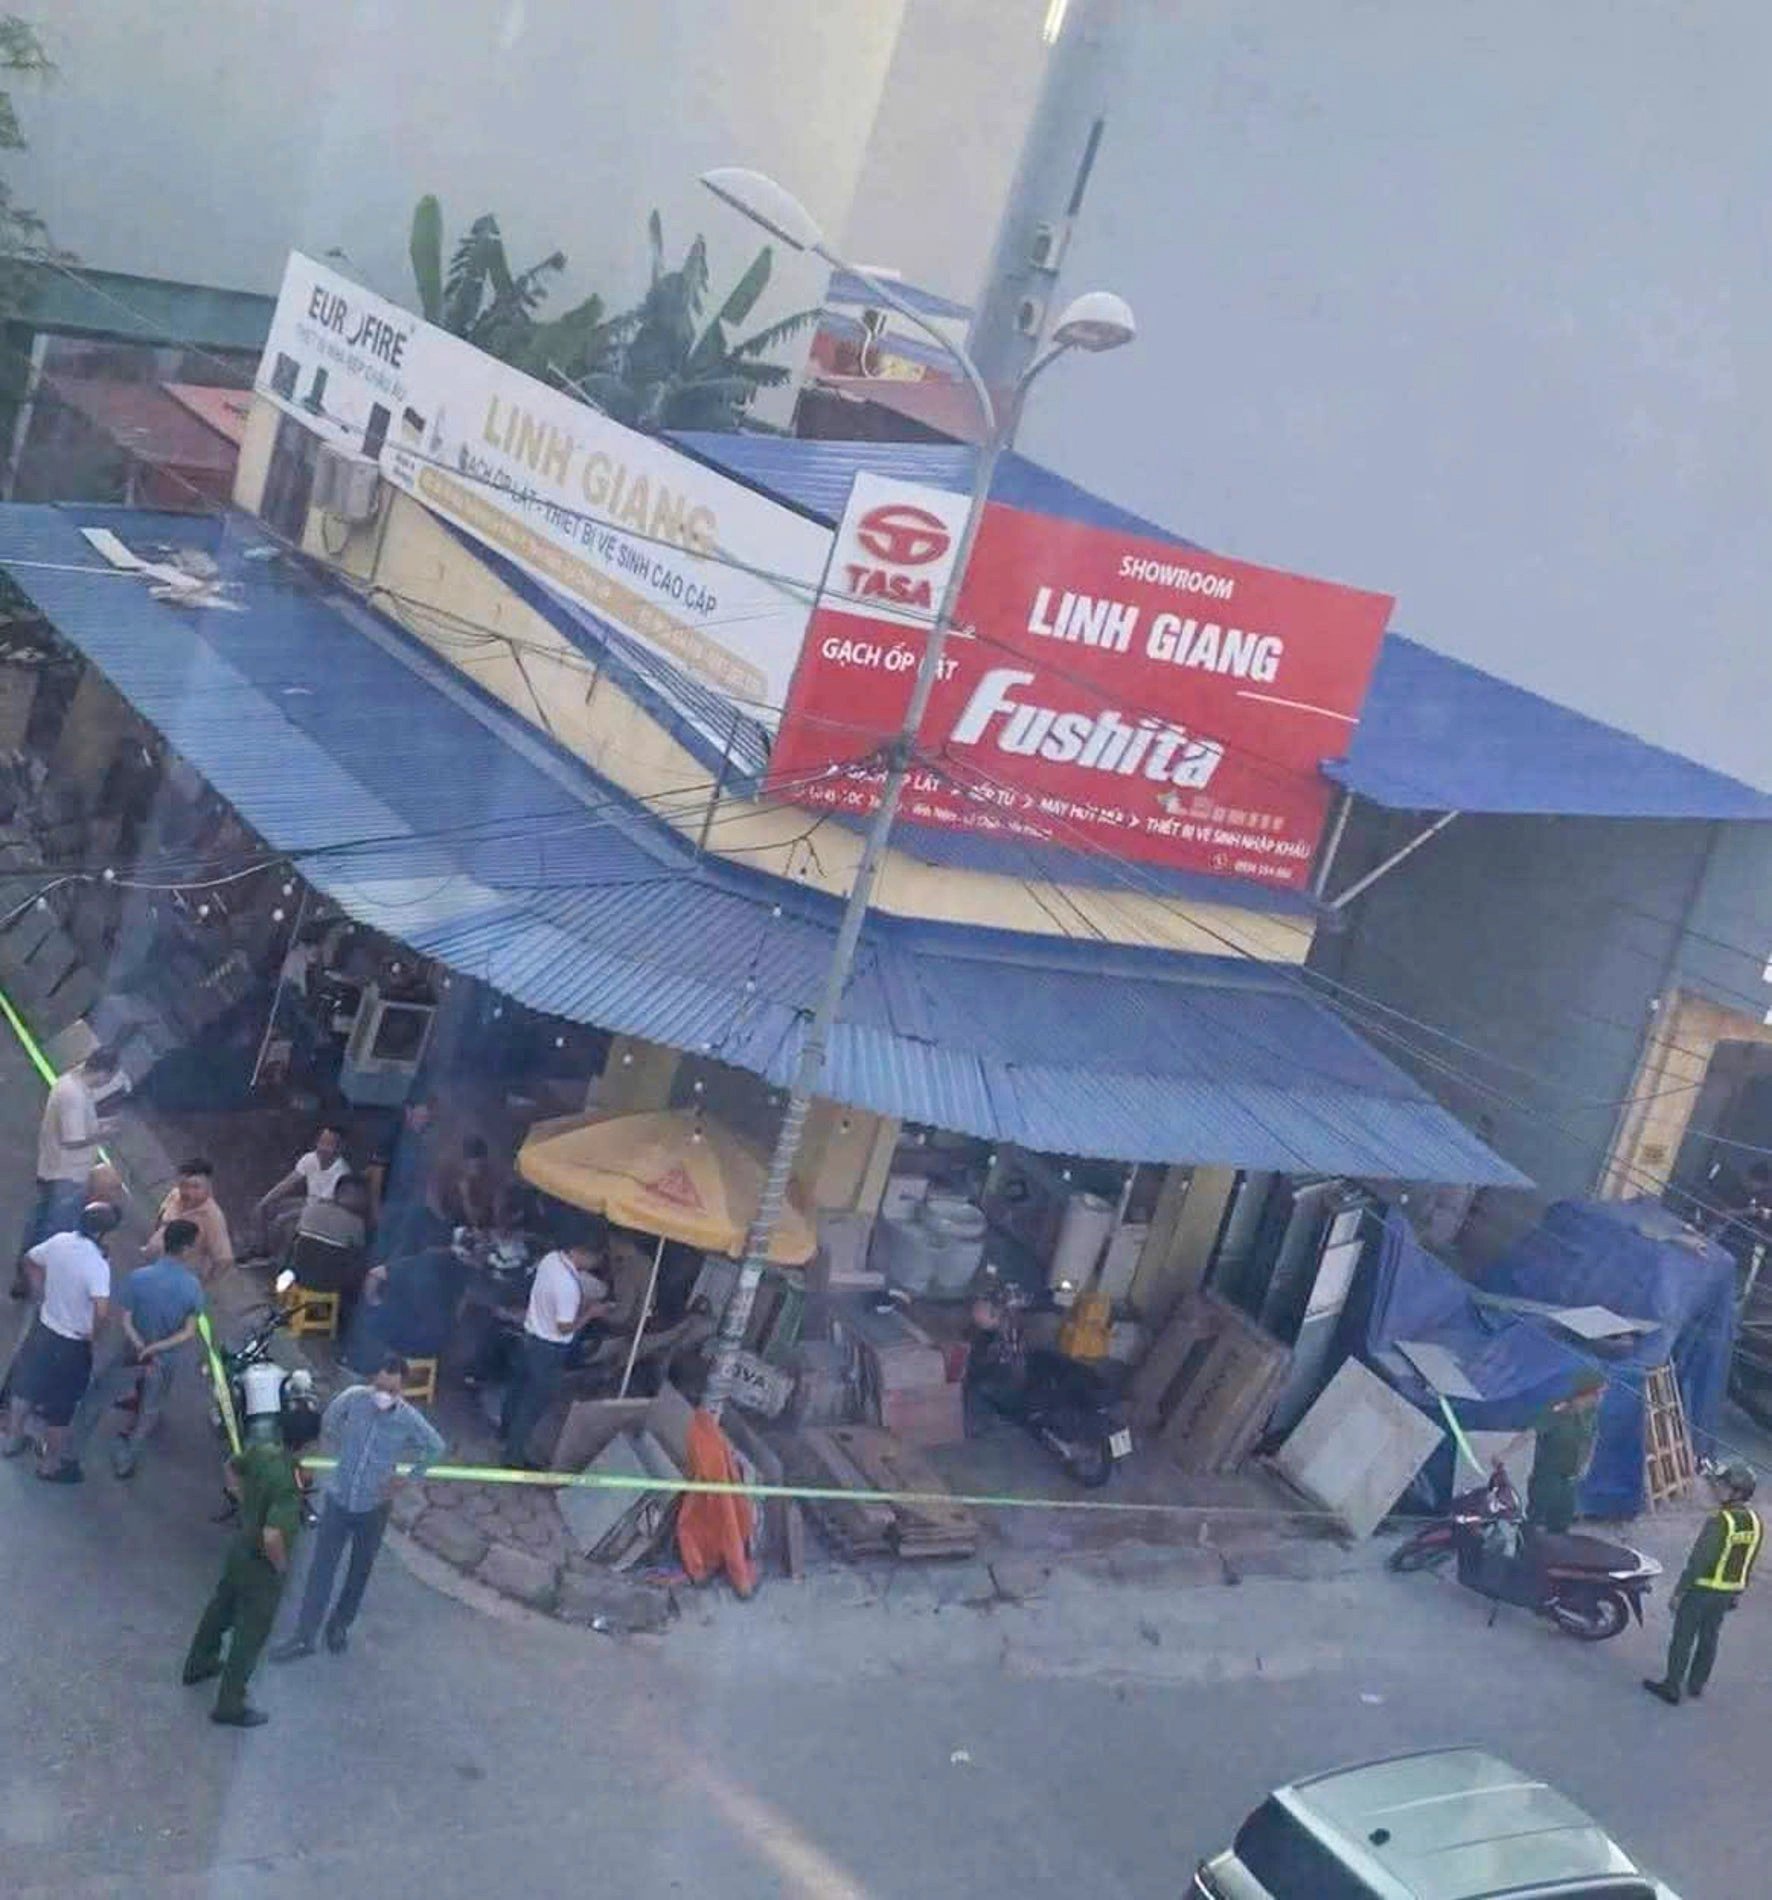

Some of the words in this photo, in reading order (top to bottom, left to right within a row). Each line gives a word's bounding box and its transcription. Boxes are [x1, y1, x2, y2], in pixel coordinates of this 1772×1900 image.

[482, 395, 574, 488] LINH
[582, 450, 718, 558] GIANG
[617, 543, 650, 580] SINH
[651, 563, 684, 599] CAO
[846, 564, 934, 609] TASA
[1119, 556, 1234, 599] SHOWROOM
[822, 637, 881, 668] GẠCH
[884, 642, 915, 672] ỐP
[1027, 586, 1140, 652] LINH
[1146, 612, 1284, 683] GIANG
